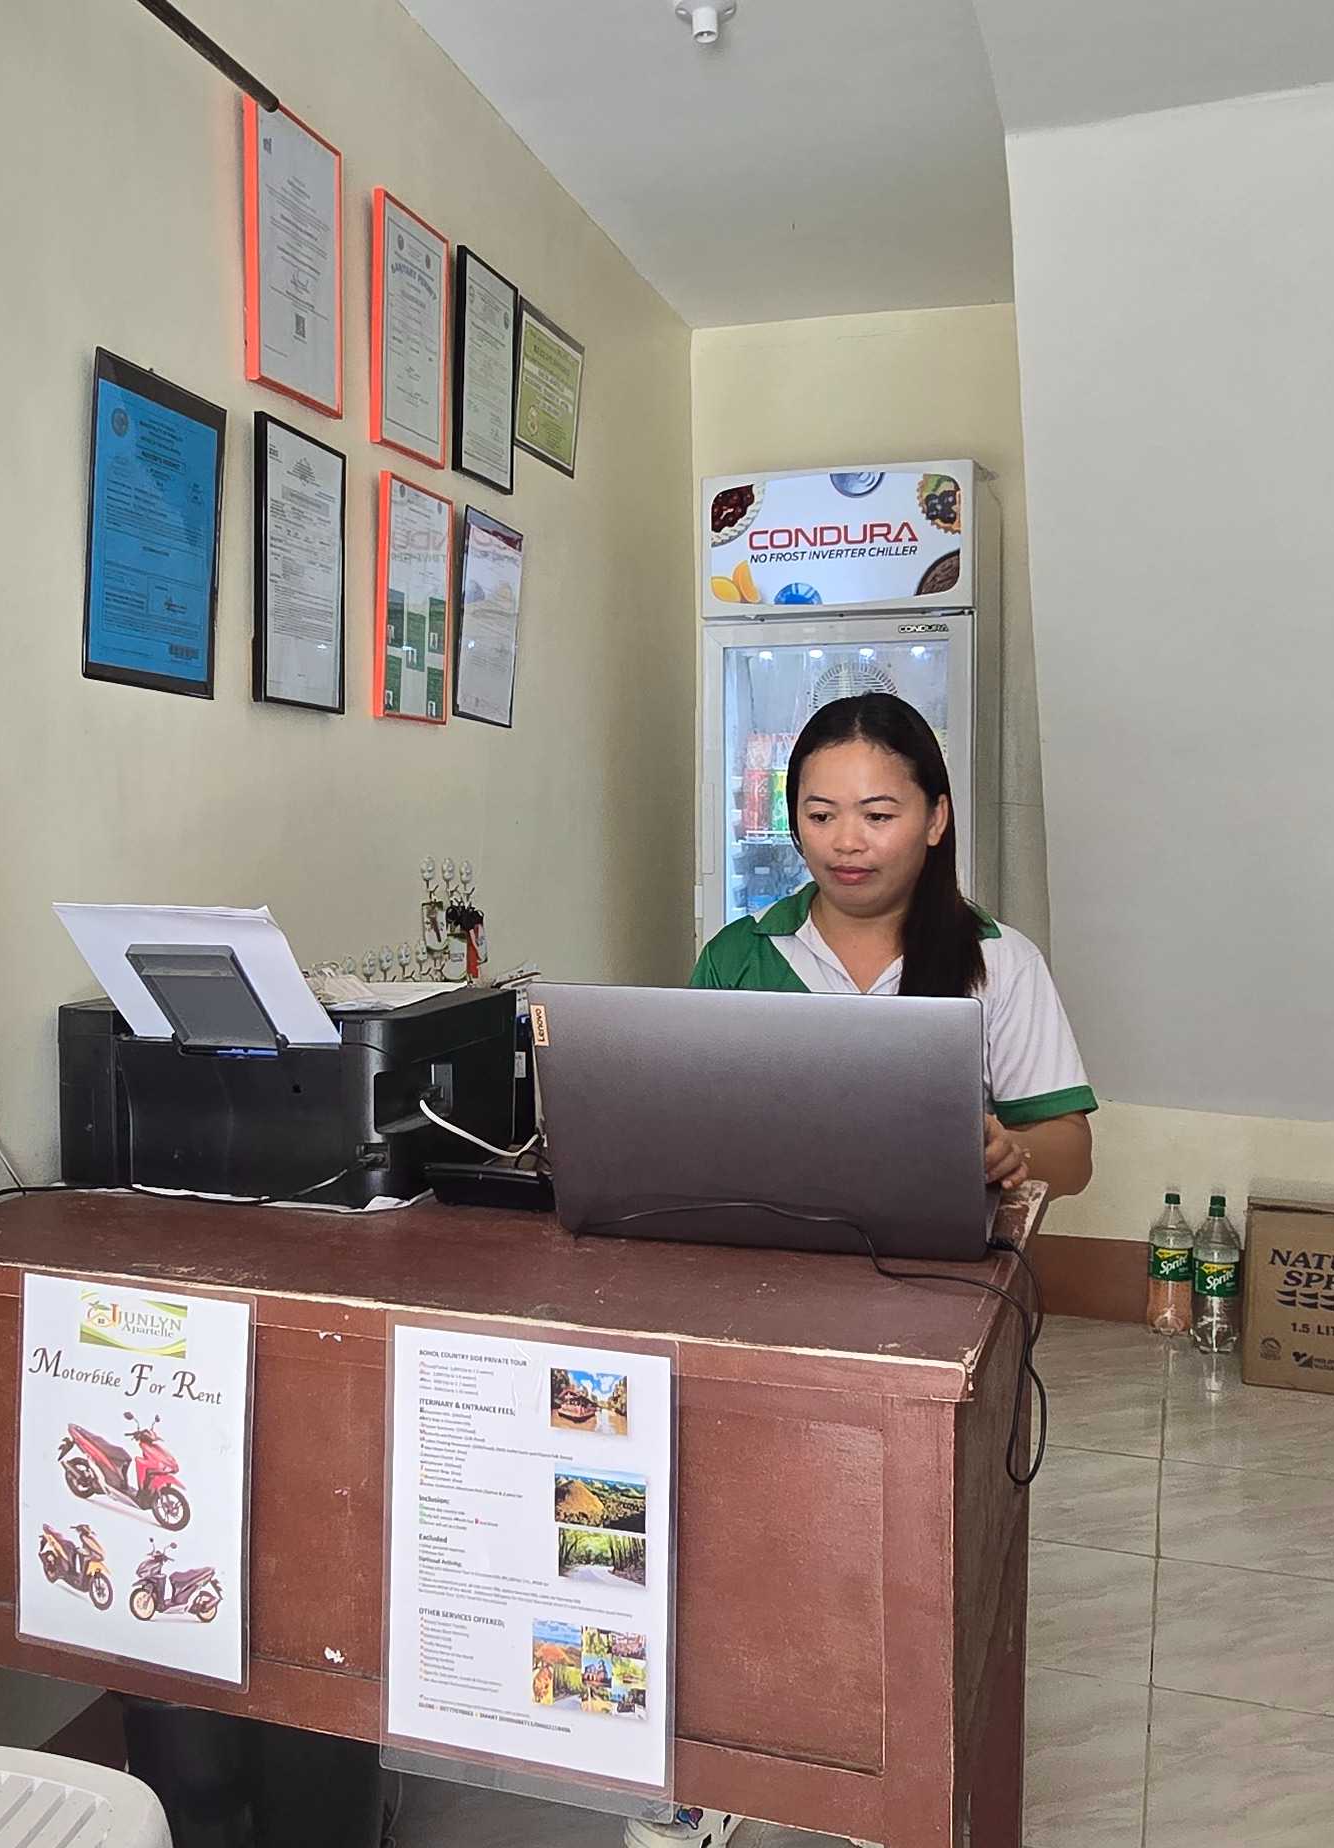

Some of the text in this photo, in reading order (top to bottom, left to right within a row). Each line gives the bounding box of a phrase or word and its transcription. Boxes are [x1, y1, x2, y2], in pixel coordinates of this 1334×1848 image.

[749, 522, 919, 550] CONDURA
[750, 545, 917, 564] NO FROST INVERTER CHILLER
[898, 624, 949, 634] CONDURA
[536, 1008, 545, 1041] Lenovo
[121, 1322, 175, 1339] Apartelle
[1291, 1322, 1310, 1334] 1.5
[419, 1350, 440, 1359] BOHOL
[441, 1351, 469, 1361] COUNTRY
[484, 1357, 509, 1366] PRIVATE
[28, 1347, 222, 1405] Motorbike For Rent
[462, 1401, 497, 1414] ENTRANCE
[419, 1607, 441, 1617] OTHER
[442, 1610, 472, 1622] SERVICES
